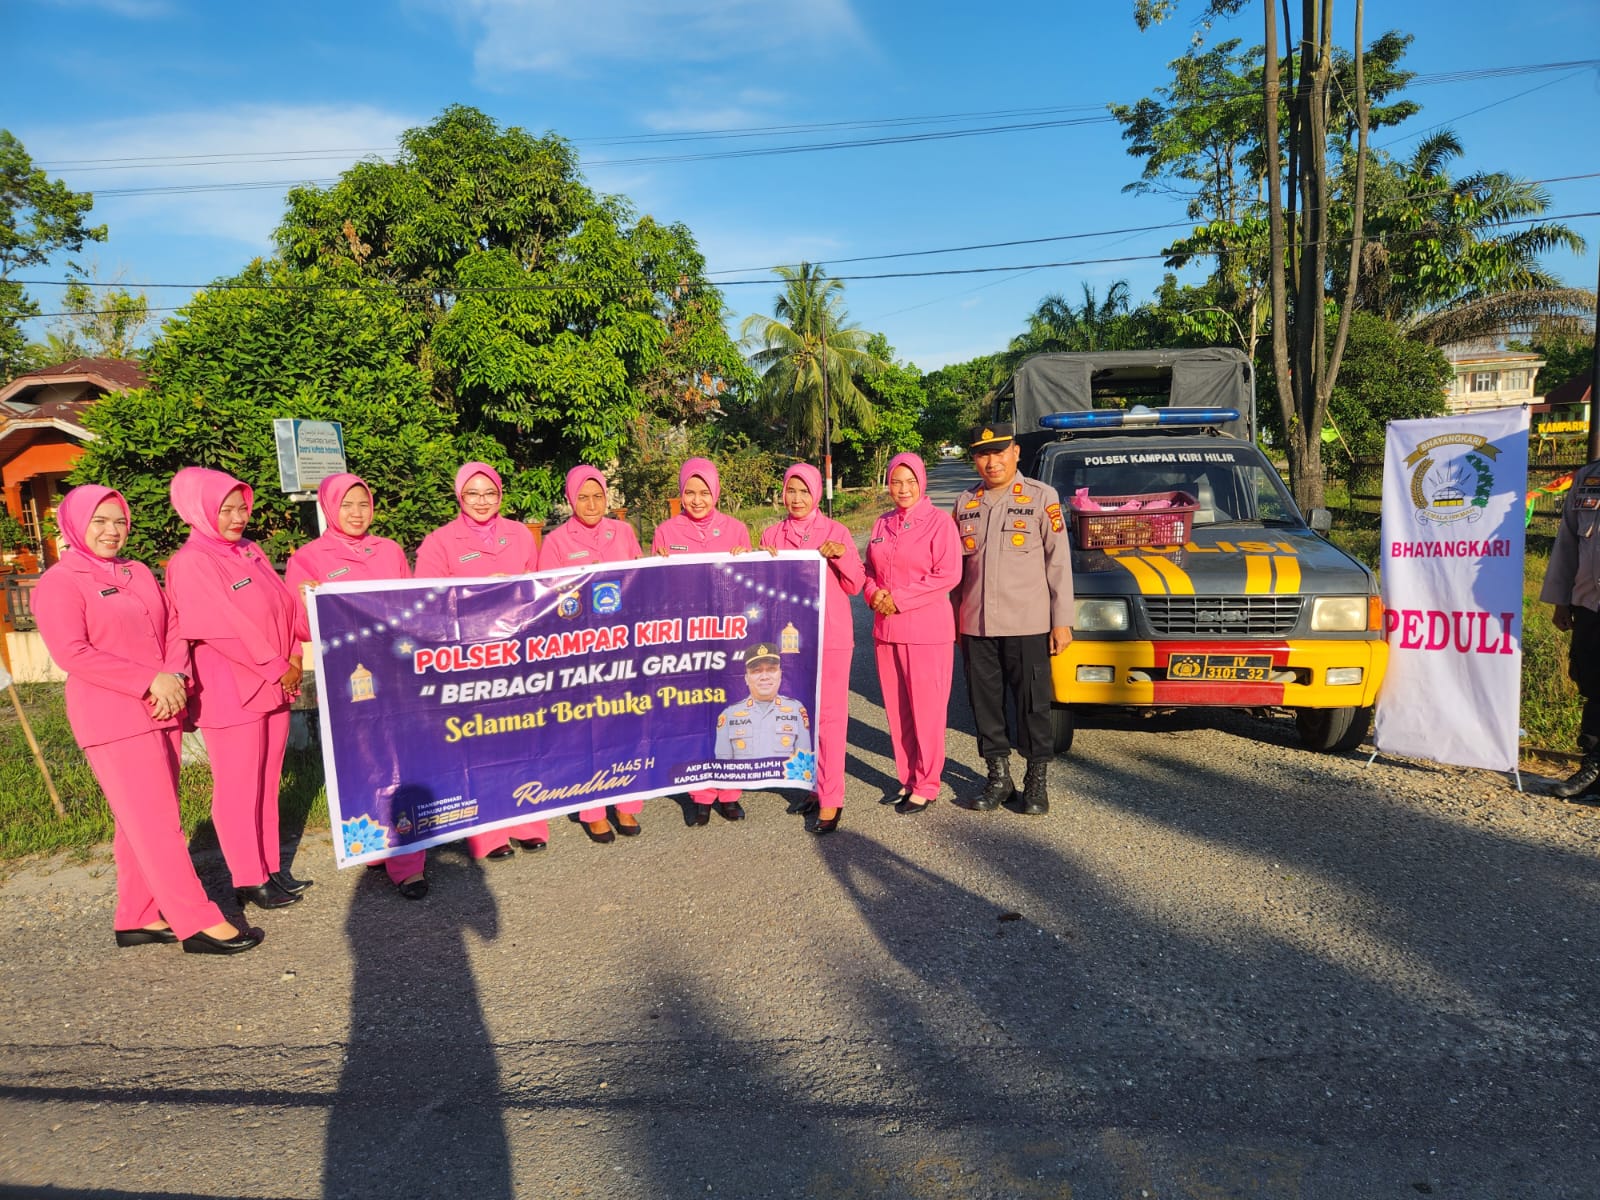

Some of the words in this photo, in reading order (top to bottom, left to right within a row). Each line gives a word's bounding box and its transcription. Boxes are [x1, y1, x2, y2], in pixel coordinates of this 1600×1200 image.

[1421, 434, 1483, 451] BHAYANGKARI
[1085, 455, 1128, 466] POLSEK
[1130, 453, 1177, 463] KAMPAR
[1178, 453, 1202, 462] KIRI
[1204, 453, 1235, 463] HILIR
[960, 511, 980, 521] ELVA
[1007, 507, 1034, 516] POLRI
[1391, 540, 1511, 558] BHAYANGKARI
[1384, 609, 1514, 655] PEDULI
[415, 640, 521, 674] POLSEK
[526, 625, 629, 663] KAMPAR
[635, 618, 682, 647] KIRI
[687, 616, 748, 642] HILIR
[1233, 656, 1248, 667] IV
[441, 671, 554, 704] BERBAGI
[559, 659, 638, 688] TAKJIL
[642, 651, 727, 676] GRATIS
[445, 707, 548, 743] Selamat
[551, 691, 653, 723] Berbuka
[656, 686, 727, 708] Puasa
[611, 758, 642, 775] 1445
[645, 757, 655, 770] H
[686, 764, 702, 773] AKP
[703, 762, 722, 771] ELVA
[674, 773, 713, 784] KAPOLSEK
[714, 772, 746, 780] KAMPAR
[512, 769, 637, 807] Ramadhan
[416, 795, 462, 810] TRANSFORMASI
[417, 804, 479, 831] PRESISI
